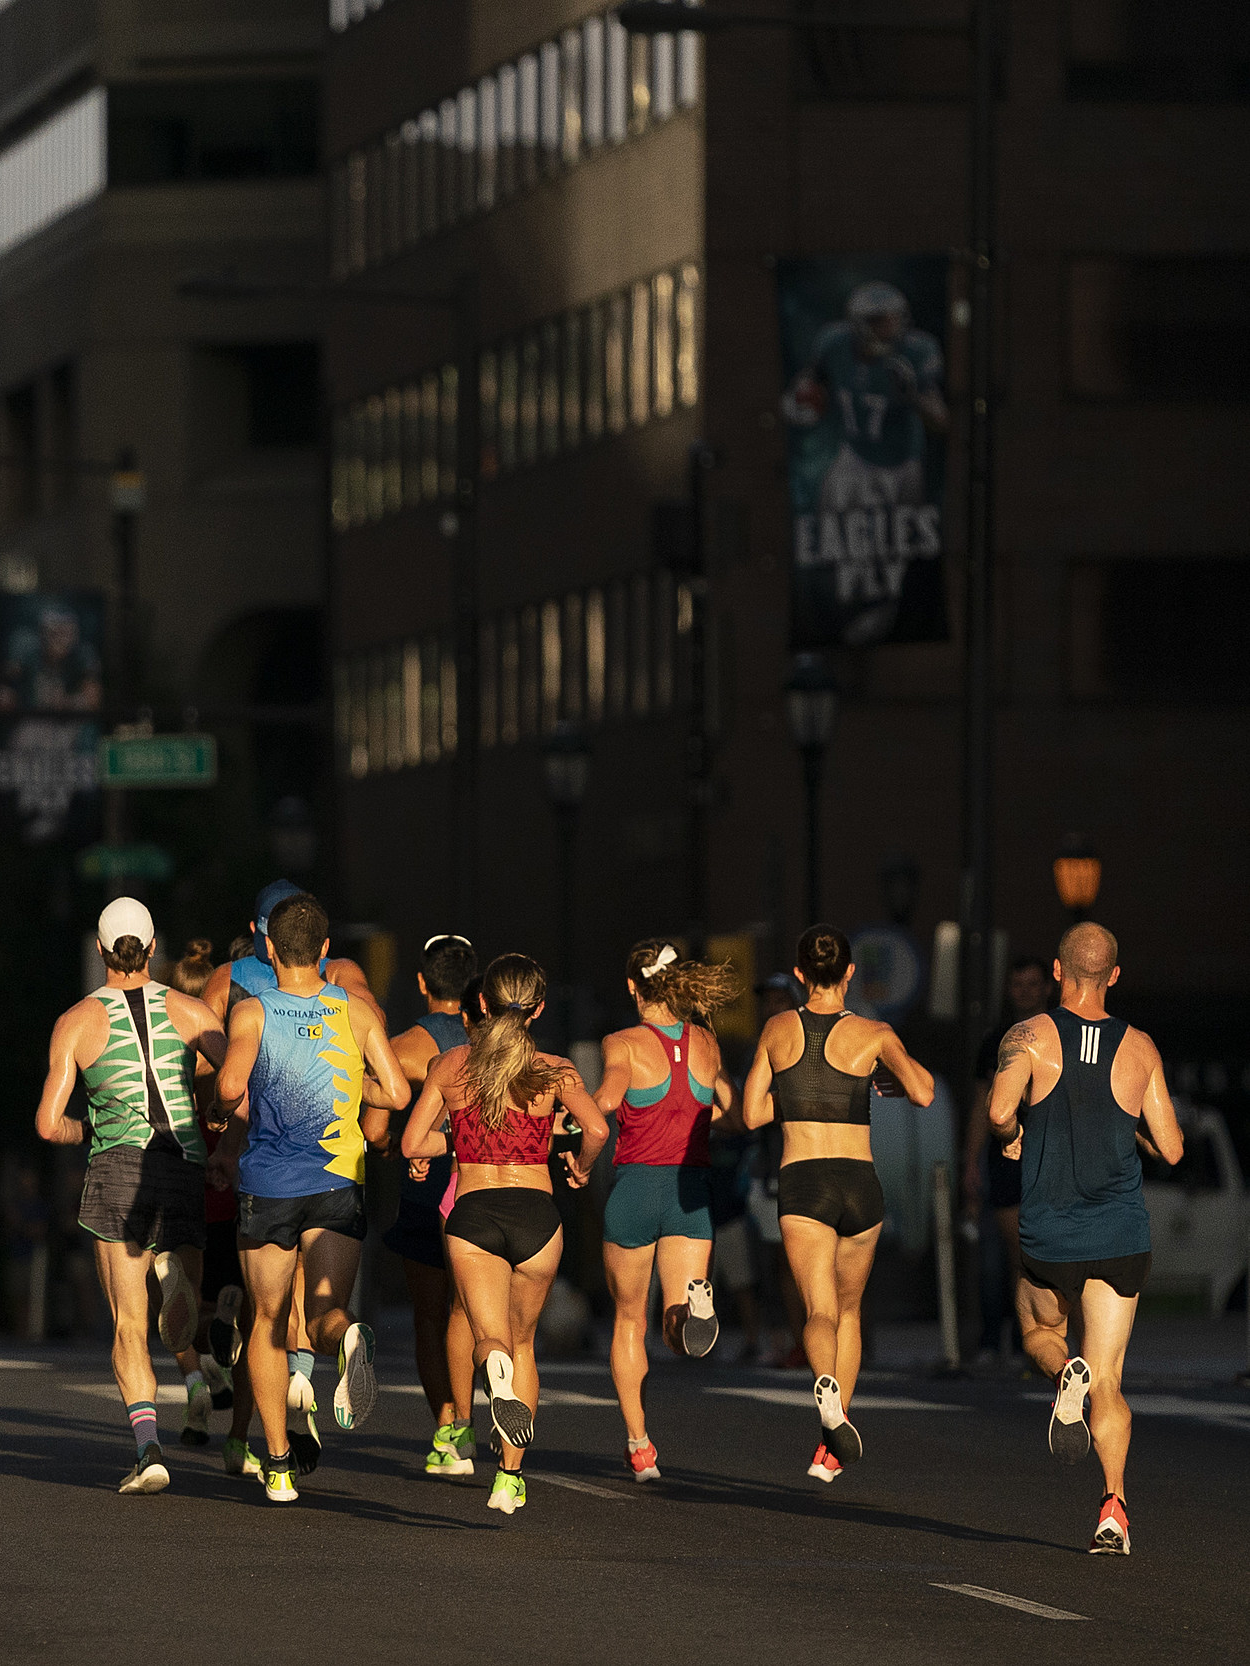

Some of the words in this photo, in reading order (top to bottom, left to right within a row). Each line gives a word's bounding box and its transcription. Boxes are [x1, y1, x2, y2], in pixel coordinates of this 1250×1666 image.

[837, 387, 888, 440] 17
[796, 505, 940, 566] EAGLES
[837, 561, 905, 602] FLY
[297, 1026, 321, 1037] CIC
